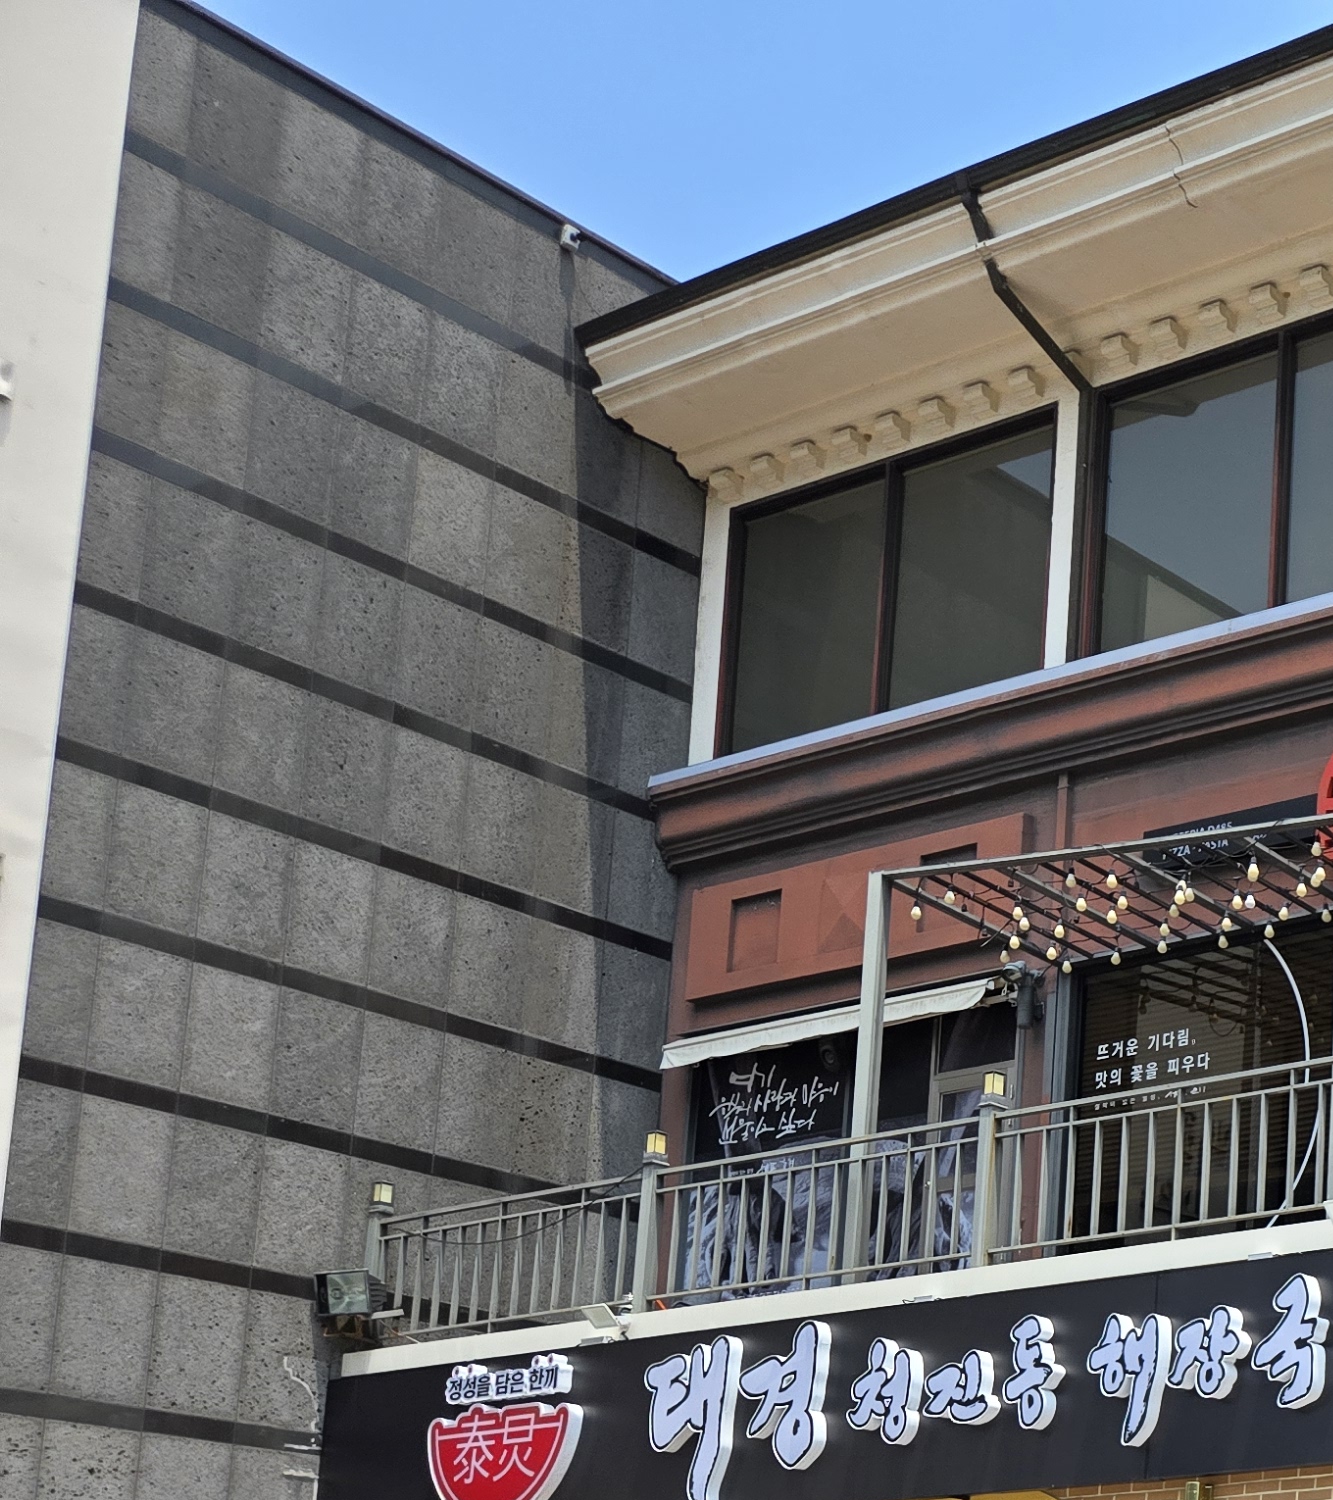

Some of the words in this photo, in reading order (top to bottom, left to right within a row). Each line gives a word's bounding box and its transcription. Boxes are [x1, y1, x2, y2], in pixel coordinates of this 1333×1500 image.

[1096, 1037, 1139, 1060] 뜨거운
[1095, 1067, 1122, 1090] 맛의
[1130, 1061, 1158, 1083] 꽃을
[1167, 1051, 1211, 1076] 피우다
[848, 1314, 1065, 1446] 청진동
[1089, 1274, 1331, 1447] 해장국
[449, 1376, 491, 1402] 정성을
[495, 1371, 525, 1397] 담은
[528, 1366, 559, 1392] 한끼
